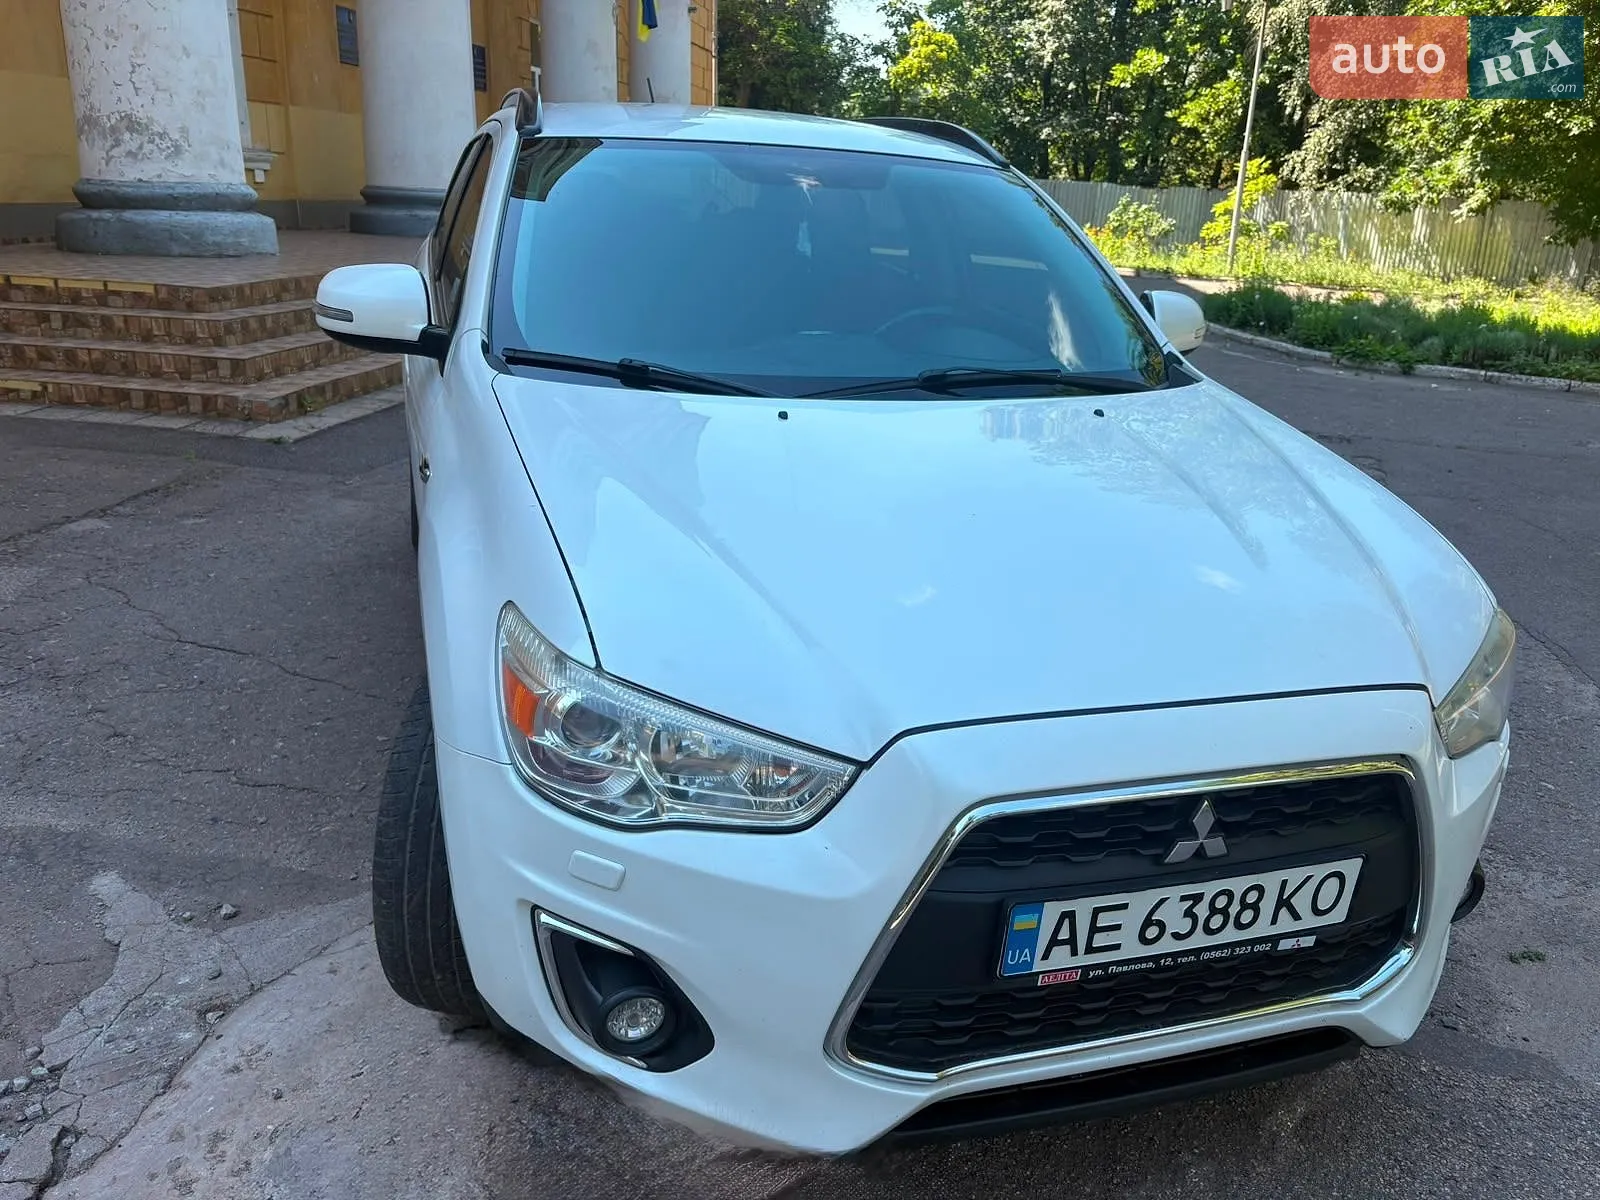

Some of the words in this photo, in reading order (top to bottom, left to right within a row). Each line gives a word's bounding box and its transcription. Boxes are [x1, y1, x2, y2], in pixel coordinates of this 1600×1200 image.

[1040, 901, 1130, 961] AE
[1137, 883, 1266, 946] 6388
[1270, 870, 1346, 926] KO
[1007, 948, 1031, 964] UA
[1087, 969, 1105, 979] ул.
[1108, 961, 1156, 974] Павлова,
[1159, 957, 1175, 967] 12,
[1177, 955, 1197, 964] тел.
[1200, 948, 1231, 960] (0562)
[1233, 945, 1251, 955] 323
[1253, 943, 1272, 952] 002
